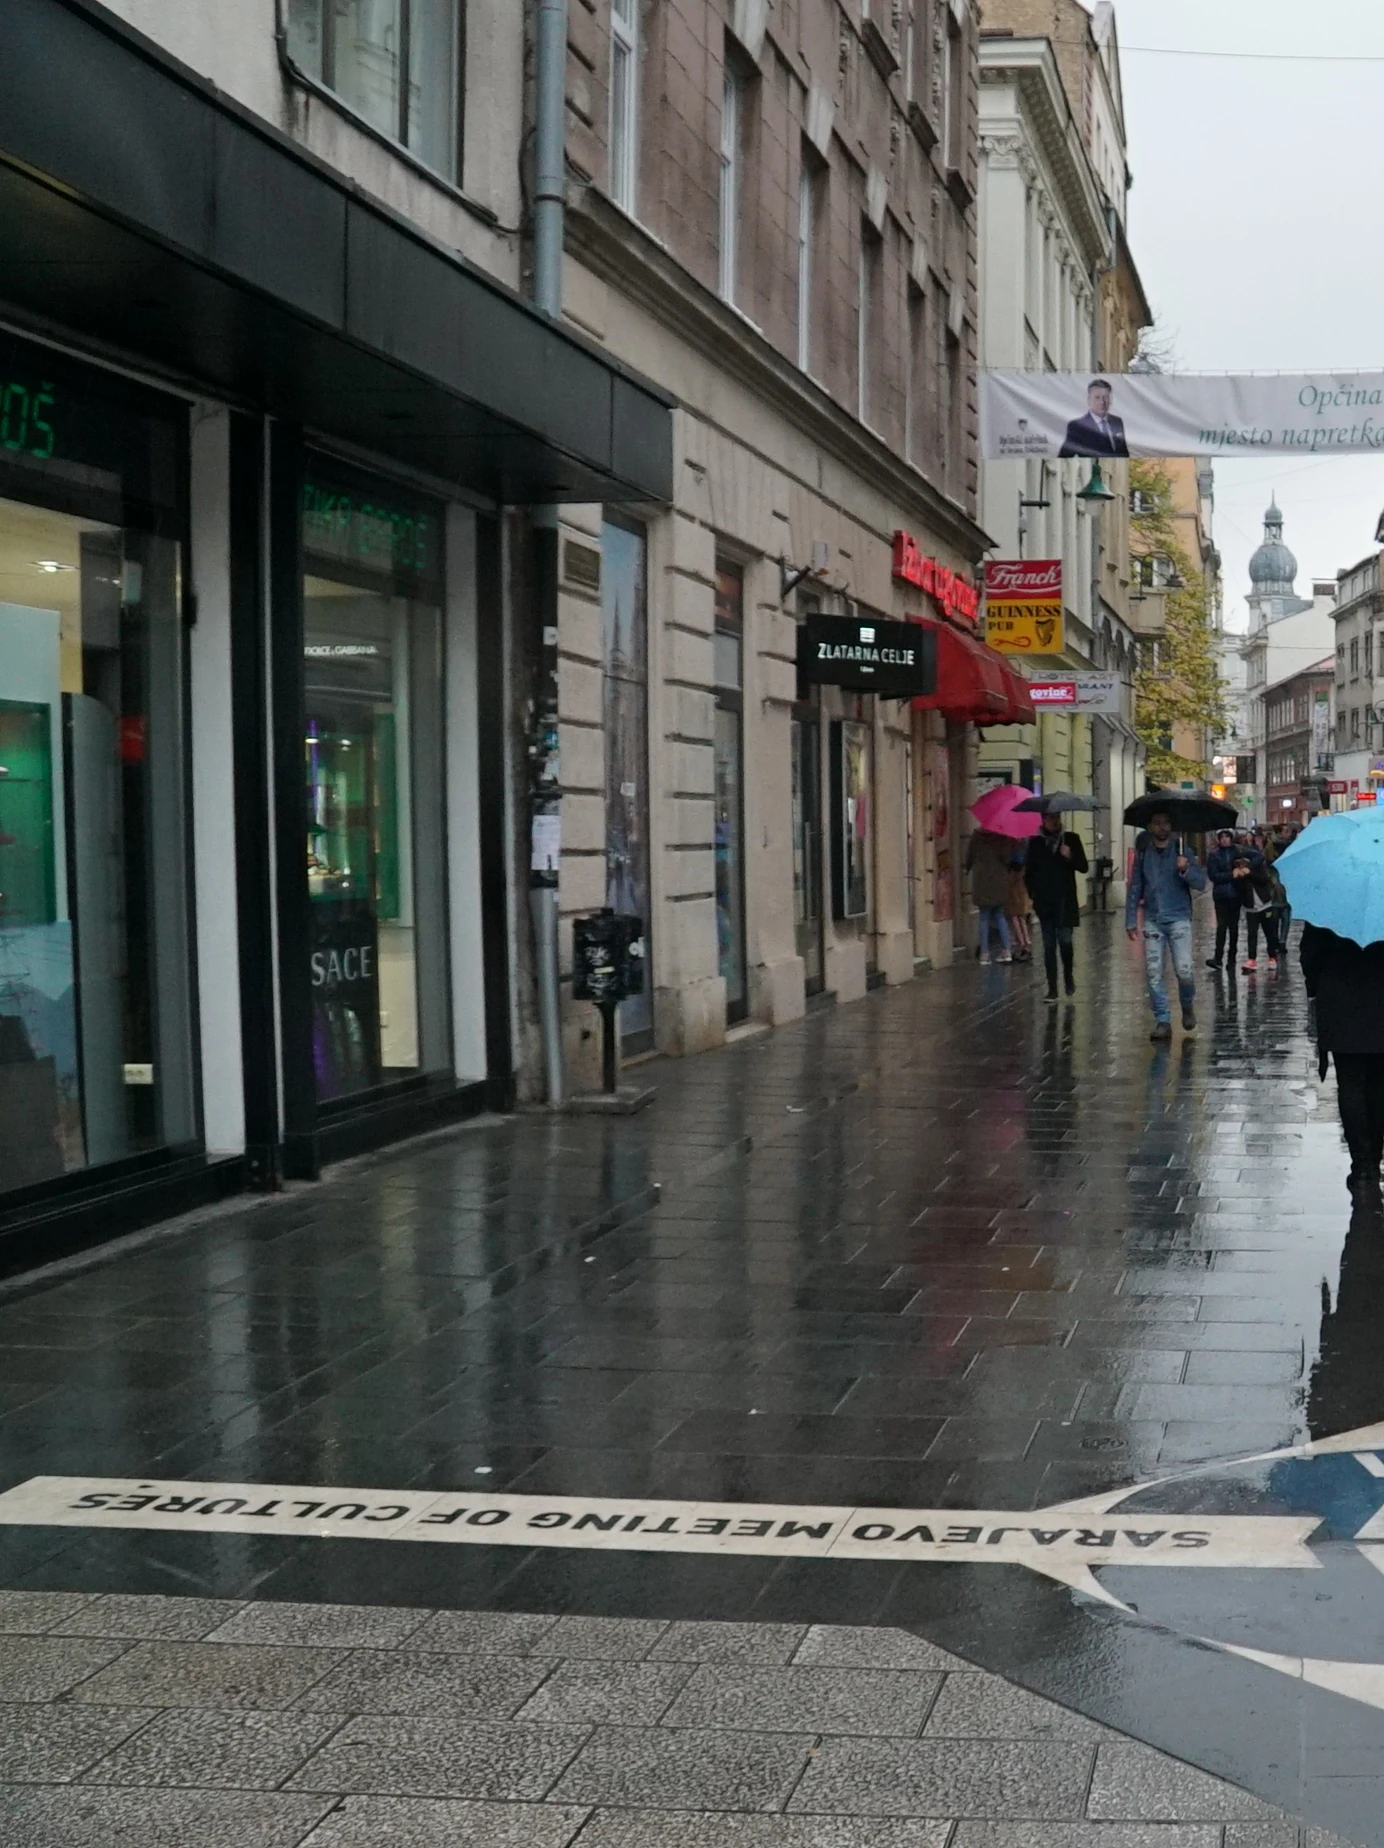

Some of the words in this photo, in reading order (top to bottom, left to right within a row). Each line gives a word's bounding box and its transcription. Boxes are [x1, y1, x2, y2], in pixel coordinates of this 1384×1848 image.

[1199, 421, 1273, 448] mjesto
[987, 605, 1062, 618] GUINNESS
[988, 621, 1014, 631] PUB
[818, 642, 880, 662] ZLATARNA
[881, 648, 915, 666] CELJE
[69, 1492, 411, 1521] CULTURES
[419, 1507, 511, 1526] OF
[526, 1510, 834, 1539] MEETING
[851, 1523, 1212, 1548] SARAJEVO
